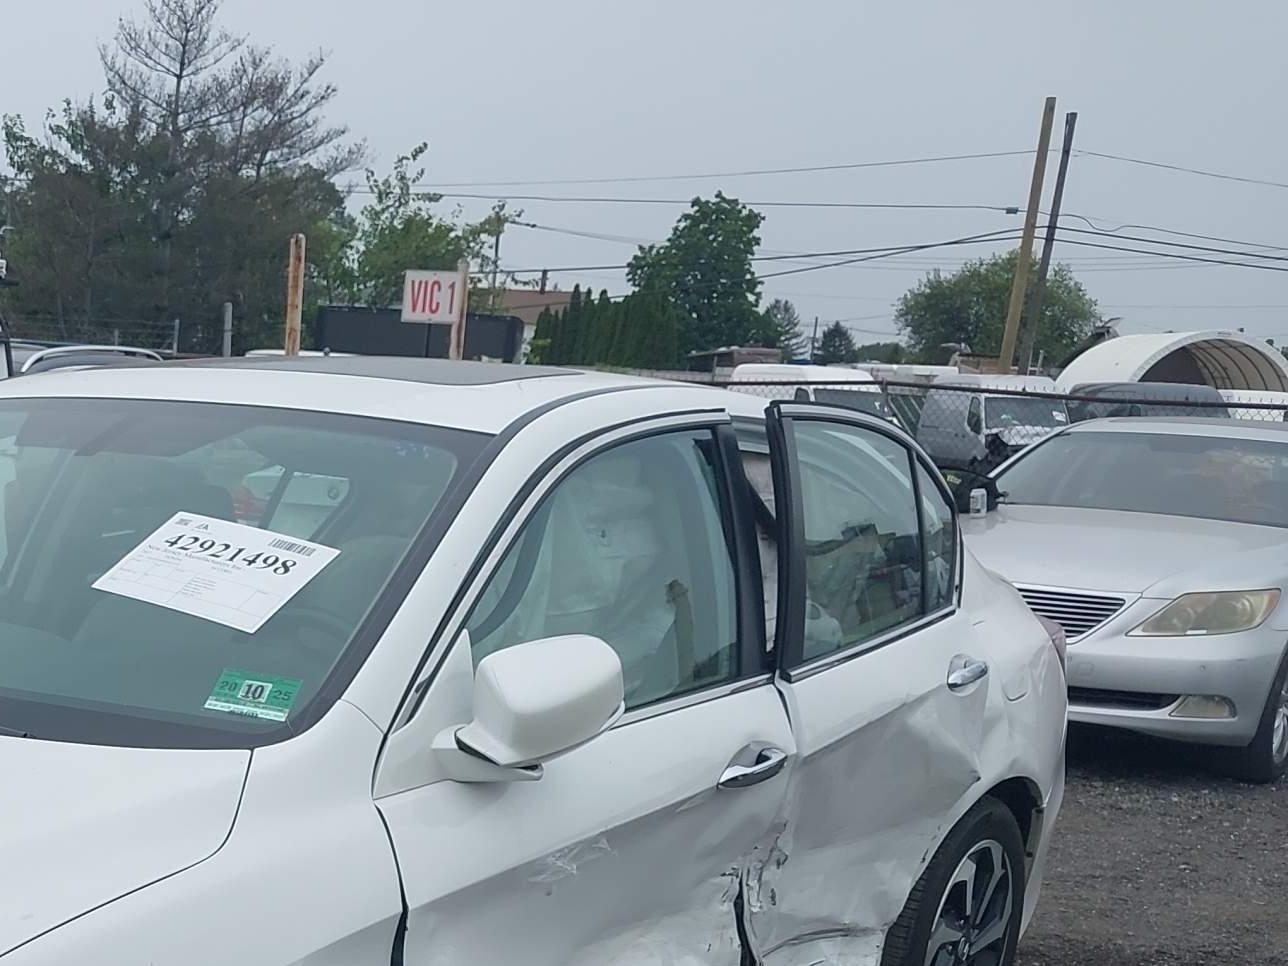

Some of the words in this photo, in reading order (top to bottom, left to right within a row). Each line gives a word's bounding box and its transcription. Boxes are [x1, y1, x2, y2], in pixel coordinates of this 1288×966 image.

[411, 280, 441, 314] VIC
[448, 281, 456, 314] 1
[164, 534, 297, 576] 42921498
[219, 681, 238, 692] 20
[241, 684, 265, 700] 10
[273, 690, 292, 701] 25
